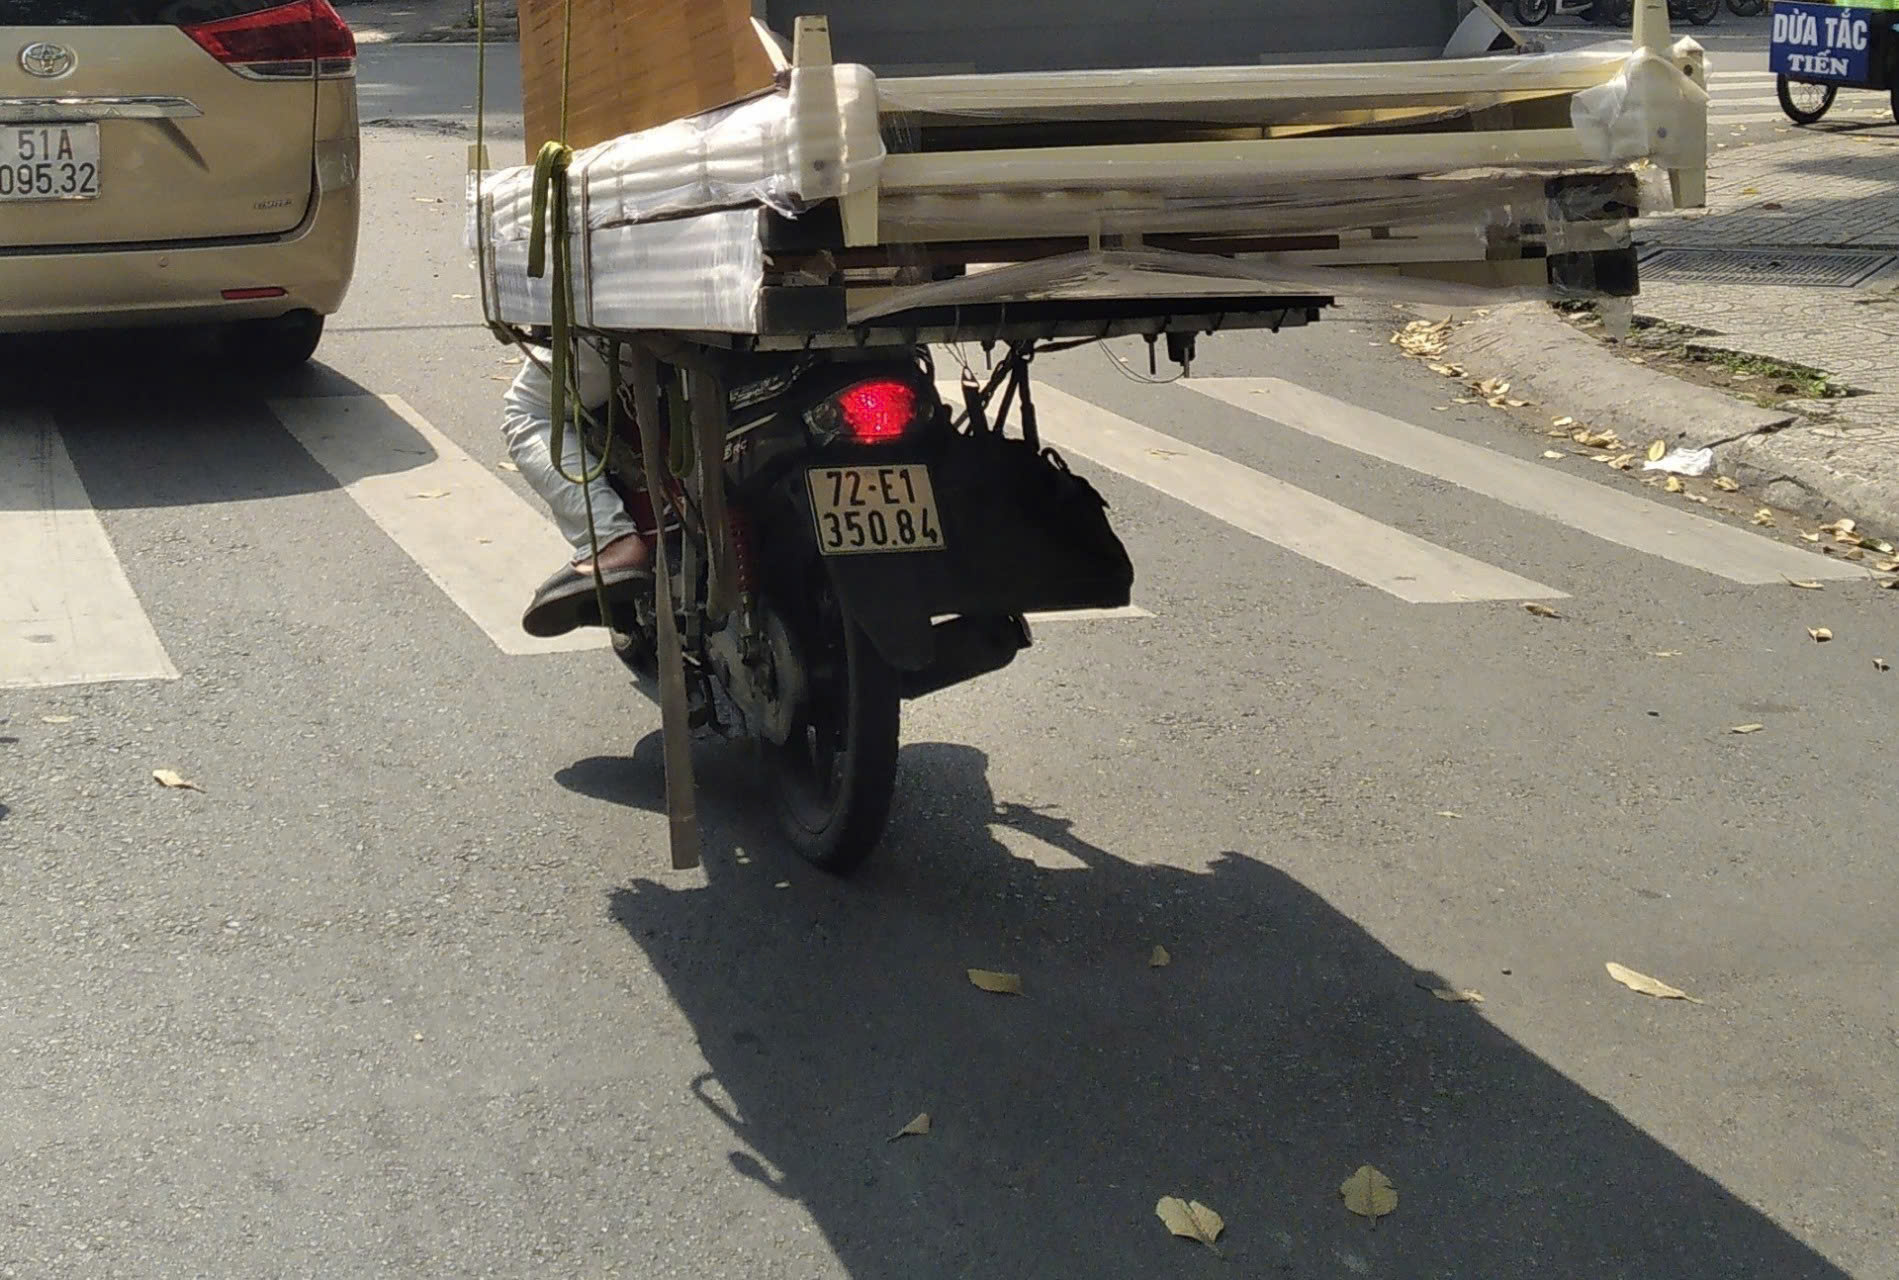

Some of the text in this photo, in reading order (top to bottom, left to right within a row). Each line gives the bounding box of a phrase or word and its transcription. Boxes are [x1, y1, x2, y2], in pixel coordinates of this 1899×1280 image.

[1773, 7, 1868, 51] DỪA TẮC
[1787, 49, 1850, 77] TIẾN
[17, 128, 74, 161] 51A
[0, 162, 97, 195] 095.32
[825, 468, 916, 507] 72-E1
[823, 507, 939, 548] 350.84
